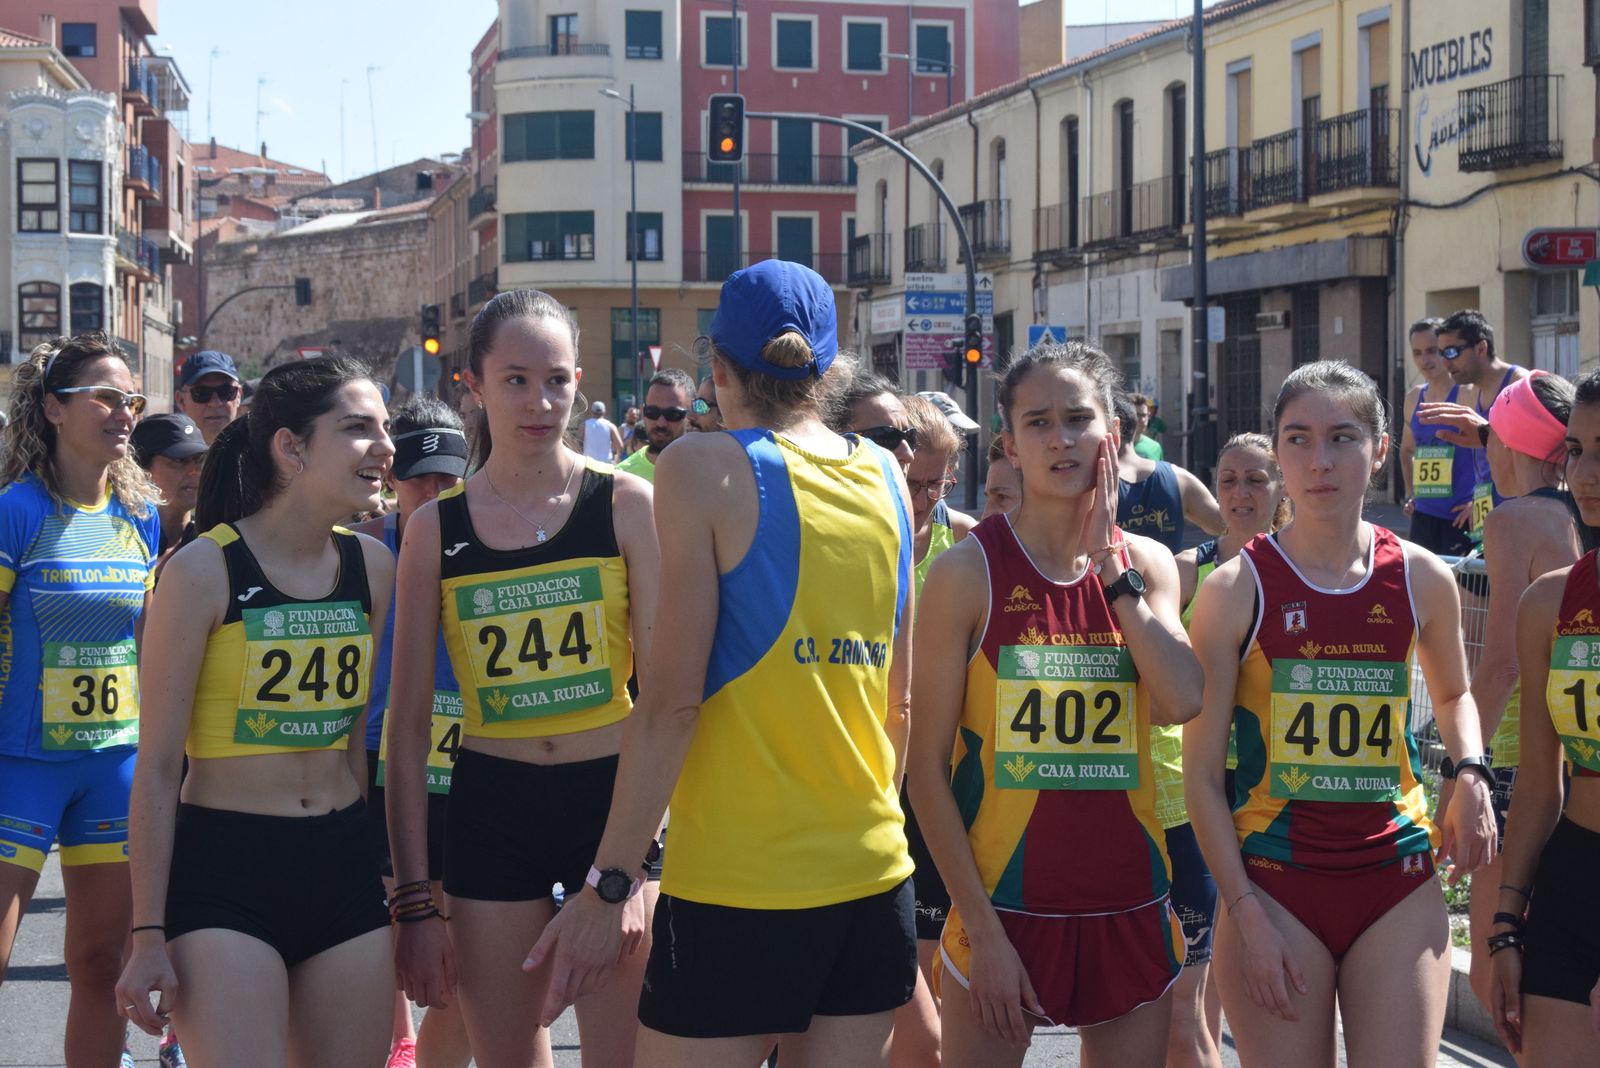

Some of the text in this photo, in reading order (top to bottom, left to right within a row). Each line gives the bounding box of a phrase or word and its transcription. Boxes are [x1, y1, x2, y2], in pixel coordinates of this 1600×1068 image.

[1411, 27, 1493, 90] MUEBLES
[1419, 462, 1440, 481] 55
[497, 576, 581, 598] FUNDACION
[499, 588, 583, 611] CAJA RURAL
[288, 608, 356, 622] FUNDACION
[289, 620, 359, 636] CAJA RURAL
[478, 611, 592, 678] 244
[1051, 631, 1127, 646] CAJA RURA
[79, 645, 133, 656] FUNDACION
[828, 638, 886, 669] ZAMORA
[1323, 643, 1387, 655] CAJA RURAL
[79, 655, 128, 666] CAJA RURAL
[1044, 652, 1119, 666] FUNDACION
[256, 644, 361, 702] 248
[1044, 665, 1119, 678] CAJA RURAL
[1317, 666, 1395, 681] FUNDACION
[1316, 679, 1393, 692] CAJA RURAL
[71, 674, 119, 716] 36
[511, 681, 604, 708] CAJA RURAL
[1010, 688, 1121, 744] 402
[75, 729, 102, 741] CAJA
[279, 721, 319, 736] CAJA
[1284, 701, 1392, 758] 404
[1038, 763, 1130, 778] CAJA RURAL
[1311, 776, 1394, 791] CAJA RURAL
